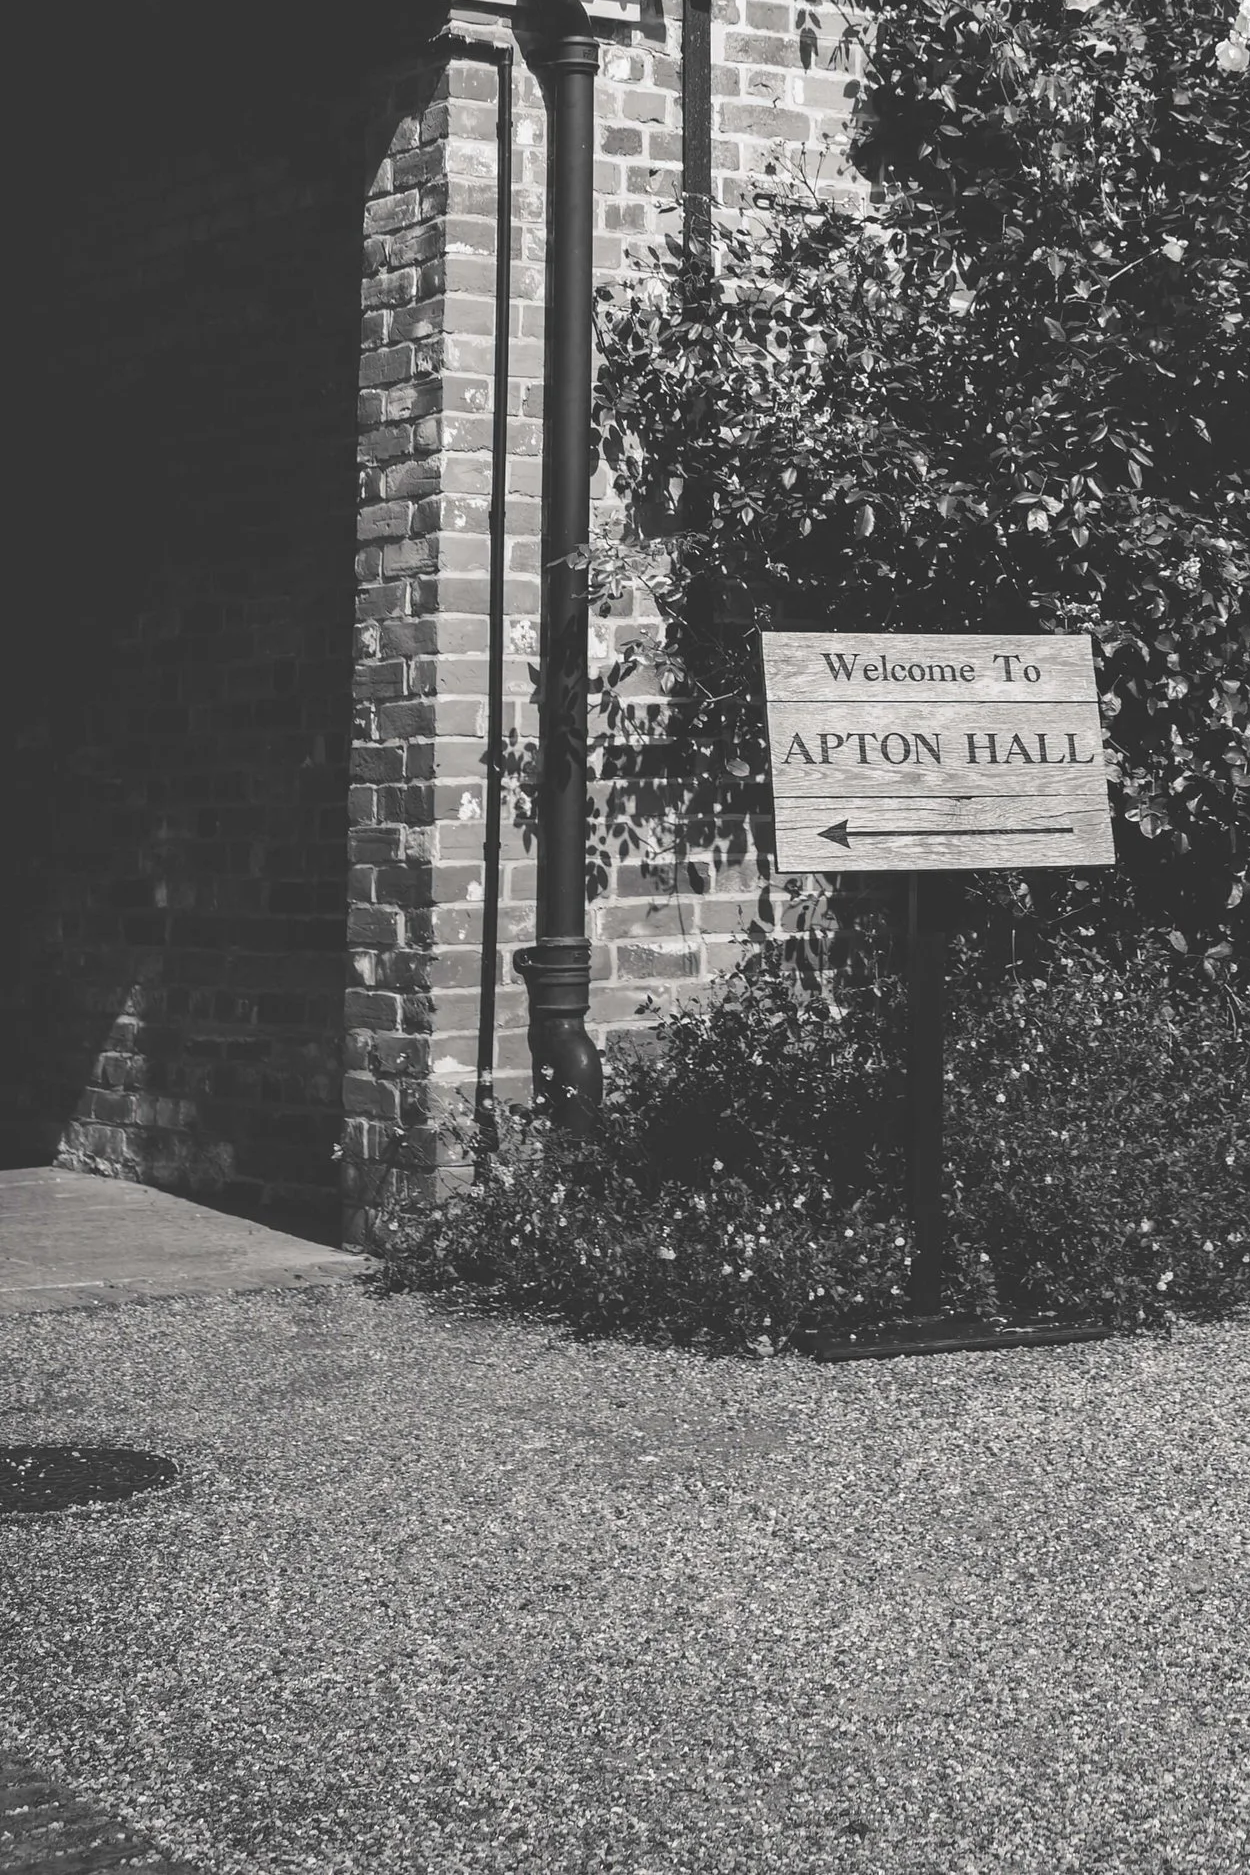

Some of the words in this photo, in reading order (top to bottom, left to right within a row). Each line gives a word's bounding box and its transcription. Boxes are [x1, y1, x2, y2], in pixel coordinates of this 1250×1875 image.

[820, 653, 975, 682] Welcome
[993, 654, 1041, 683] To
[781, 732, 942, 765] APTON
[964, 733, 1095, 764] HALL
